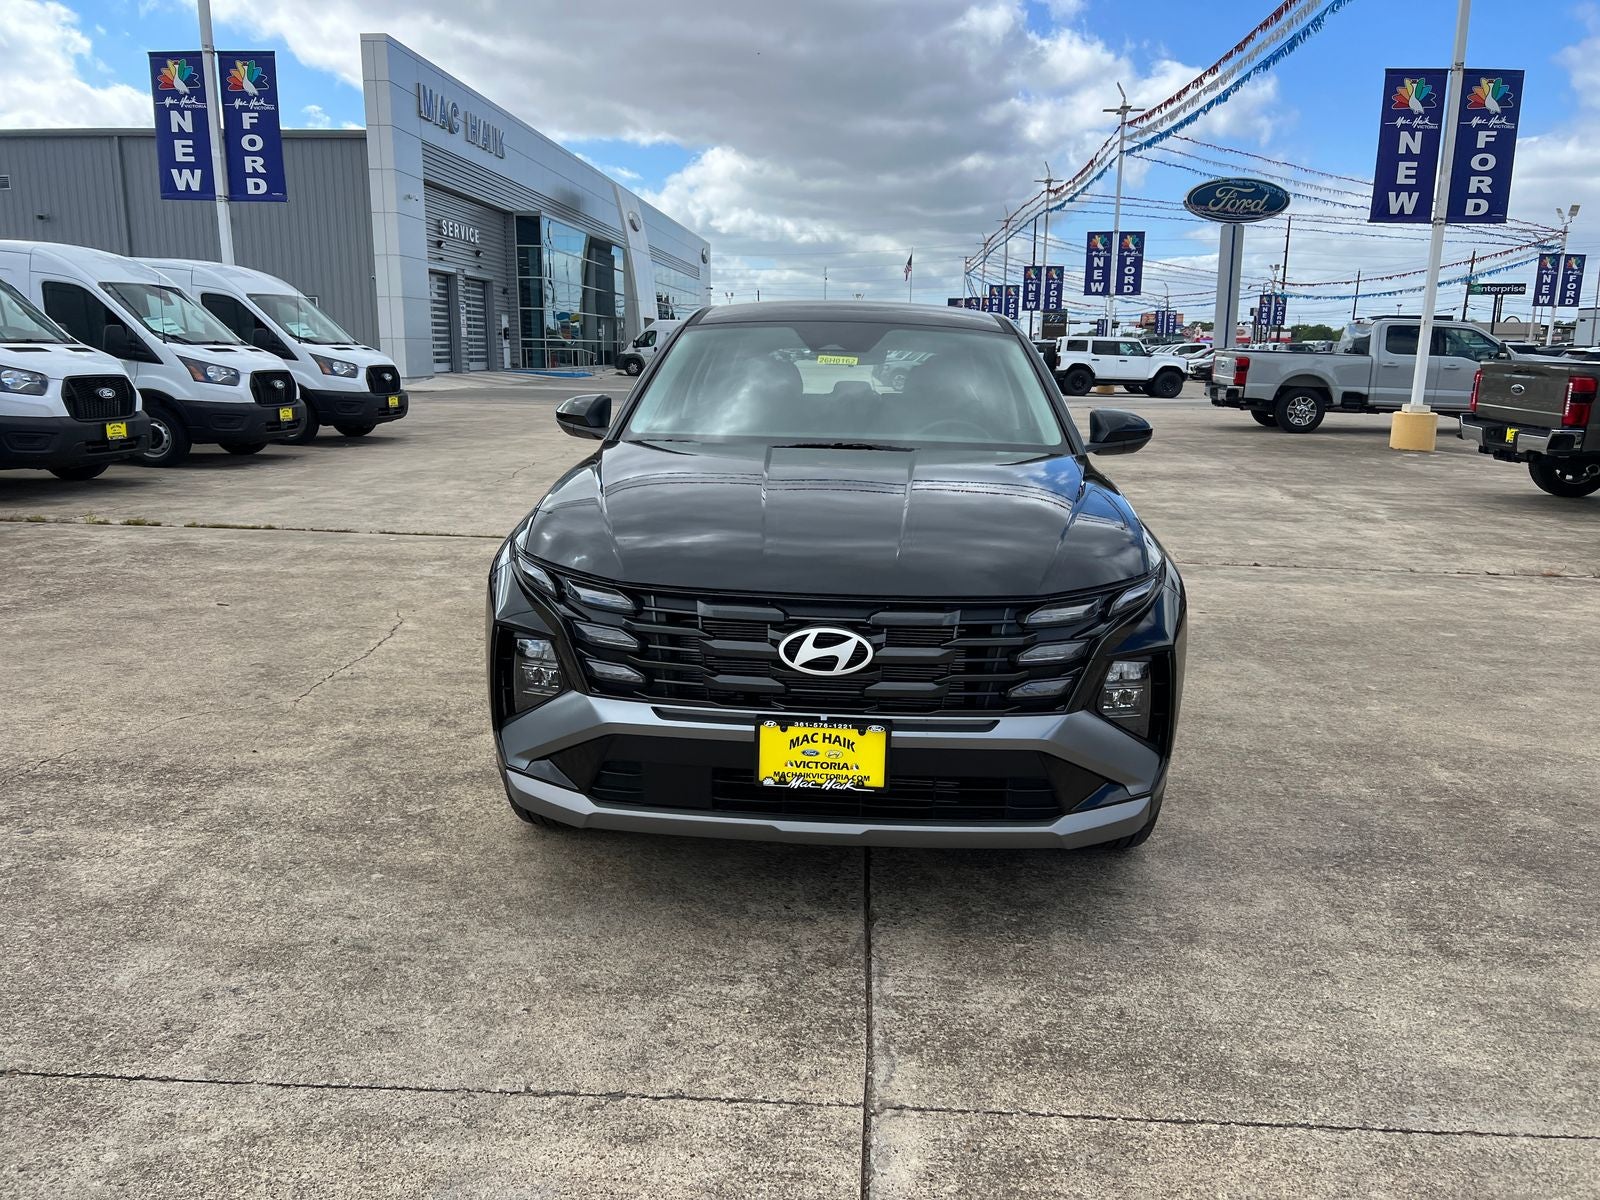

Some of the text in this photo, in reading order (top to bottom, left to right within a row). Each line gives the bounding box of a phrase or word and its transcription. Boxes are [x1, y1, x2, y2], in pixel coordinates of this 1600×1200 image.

[163, 95, 201, 108] Mac Haik
[233, 97, 268, 110] Mac Haik
[416, 82, 506, 159] MAC HAIK
[1395, 115, 1432, 128] Mac Haik
[1470, 115, 1508, 128] Mac Haik
[170, 110, 202, 191] NEW
[241, 112, 268, 195] FORD
[1388, 131, 1423, 215] NEW
[1465, 130, 1498, 216] FORD
[1208, 186, 1270, 212] Ford
[442, 219, 480, 244] SERVICE
[1090, 256, 1105, 293] NEW
[1123, 256, 1136, 293] FORD
[1025, 283, 1036, 309] NEW
[1049, 283, 1058, 310] FORD
[1474, 284, 1526, 294] enterprise
[1538, 274, 1552, 304] NEW
[1564, 275, 1577, 305] FORD
[789, 732, 856, 752] MAC HAIK
[773, 771, 870, 782] MACHAIKVICTORIA.COM
[794, 760, 850, 771] VICTORIA
[788, 777, 856, 790] Mac Haik
